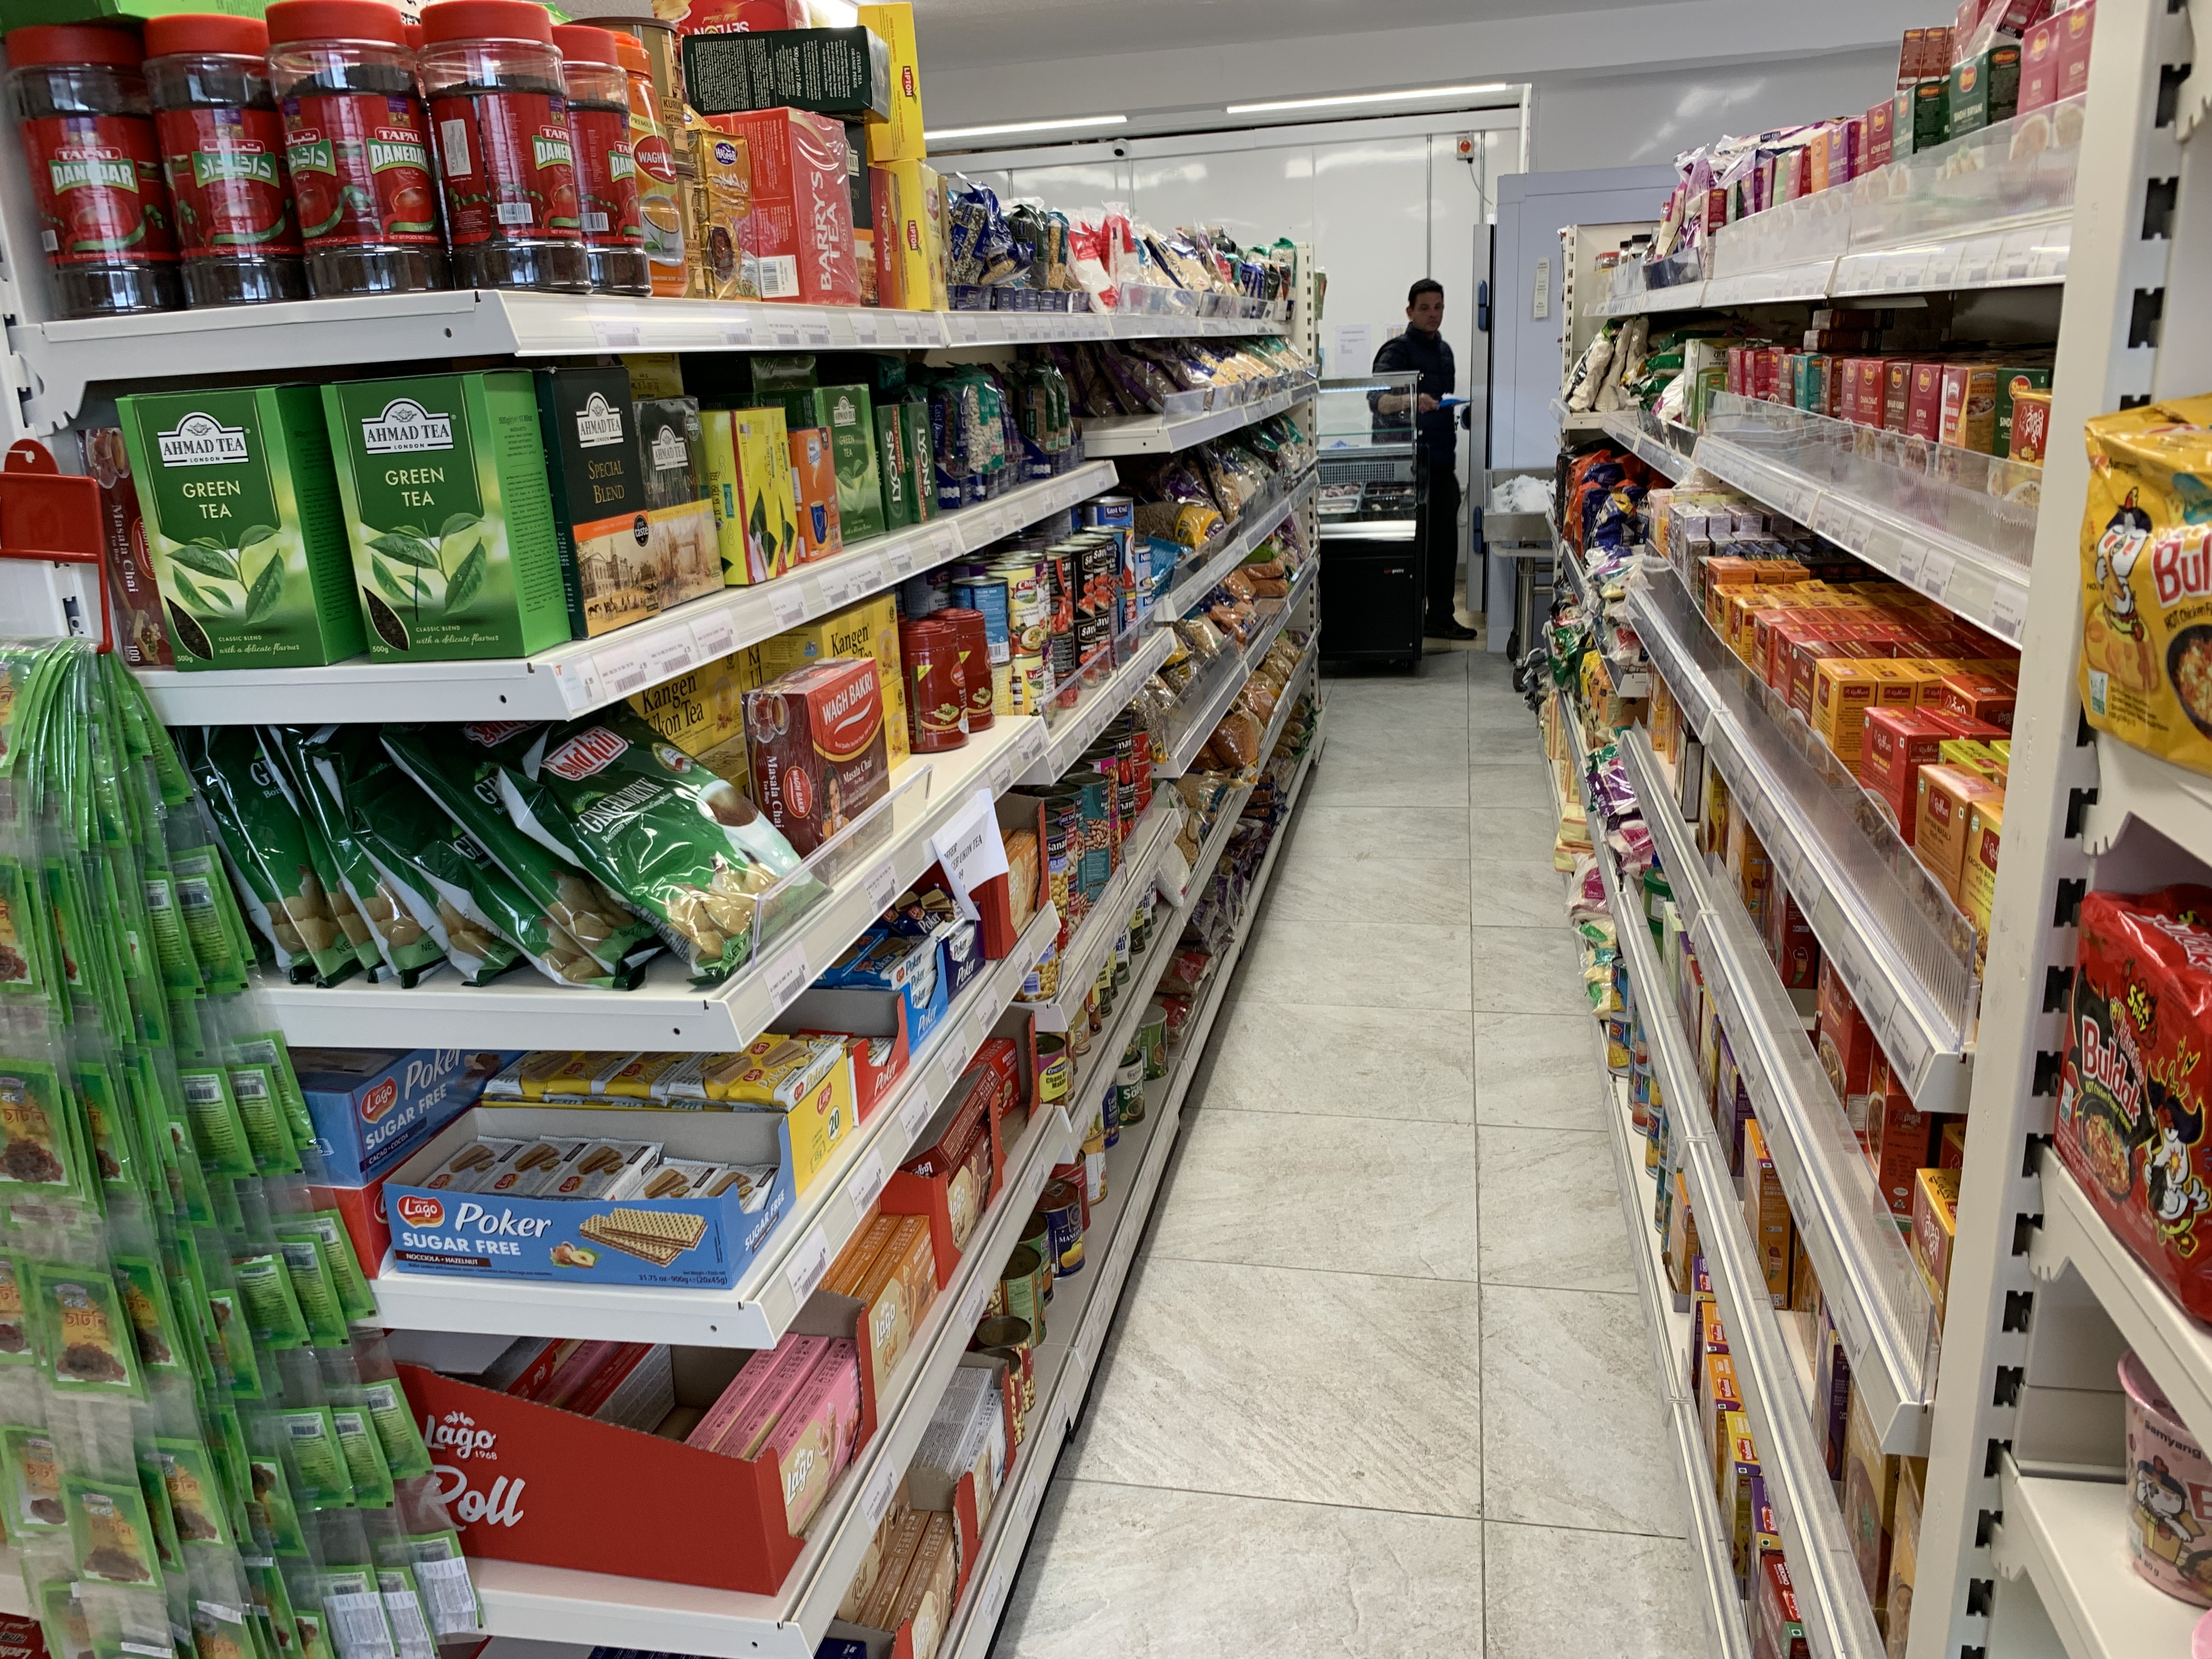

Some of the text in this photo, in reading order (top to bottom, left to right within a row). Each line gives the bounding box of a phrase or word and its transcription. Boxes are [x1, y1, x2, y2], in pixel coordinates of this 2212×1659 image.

[380, 131, 420, 143] TAPAL
[638, 151, 662, 165] WAGH
[53, 165, 134, 188] DANDAR
[811, 171, 832, 290] BARRY'S
[828, 202, 840, 264] TEA
[366, 424, 450, 443] AHMAD TEA
[581, 418, 621, 436] AHMAD TEA
[839, 435, 855, 445] GREEN
[163, 438, 245, 456] AHMAD TEA
[655, 446, 686, 460] AHMAD TEA
[844, 448, 853, 458] TEA
[589, 461, 624, 480] SPECIAL
[887, 431, 901, 501] LYONS
[917, 428, 932, 496] LYONS
[183, 481, 241, 498] GREEN
[386, 468, 445, 486] GREEN
[402, 491, 435, 507] TEA
[593, 484, 625, 504] BLEND
[199, 503, 232, 518] TEA
[634, 527, 649, 538] taste
[111, 505, 139, 593] Masala Chai
[244, 644, 272, 653] delicate
[273, 644, 300, 654] flavour
[373, 646, 389, 654] 500g
[416, 636, 433, 644] with
[442, 635, 470, 644] delicate
[471, 634, 499, 645] flavour
[832, 624, 870, 656] Kangen
[130, 645, 140, 662] 100
[644, 674, 697, 714] Kangen
[822, 672, 873, 725] WAGH BAKRI
[681, 697, 704, 727] Tea
[843, 757, 873, 784] Masala Chai
[767, 756, 785, 828] Masala Chai
[792, 770, 805, 813] WAGH BAKRI
[960, 834, 983, 866] UKON TEA
[918, 911, 941, 933] Poker
[953, 938, 967, 959] Poker
[905, 953, 923, 976] Poker
[956, 959, 976, 987] Poker
[911, 969, 926, 988] Poker
[912, 986, 927, 1008] Poker
[2128, 984, 2146, 1032] Spicy
[918, 1005, 938, 1037] Poker
[405, 1048, 461, 1099] Poker
[804, 1064, 825, 1092] Poker
[874, 1059, 899, 1097] Poker
[2082, 1015, 2141, 1126] Buldak
[365, 1084, 396, 1114] Lago
[366, 1084, 448, 1149] SUGAR FREE
[829, 1109, 840, 1137] 20
[369, 1133, 409, 1165] CACAO COCOA
[405, 1198, 438, 1217] Lago
[455, 1201, 553, 1239] Poker
[745, 1188, 785, 1251] SUGAR FREE
[402, 1232, 521, 1256] SUGAR FREE
[406, 1253, 478, 1266] NOCCIOLA HAZELNUT
[697, 1276, 728, 1285] (20x45g)
[876, 1302, 896, 1348] Lago
[882, 1340, 902, 1372] Roll
[424, 1414, 497, 1460] Lago
[475, 1450, 498, 1460] 1968
[786, 1449, 815, 1506] Lago
[421, 1463, 526, 1532] Roll
